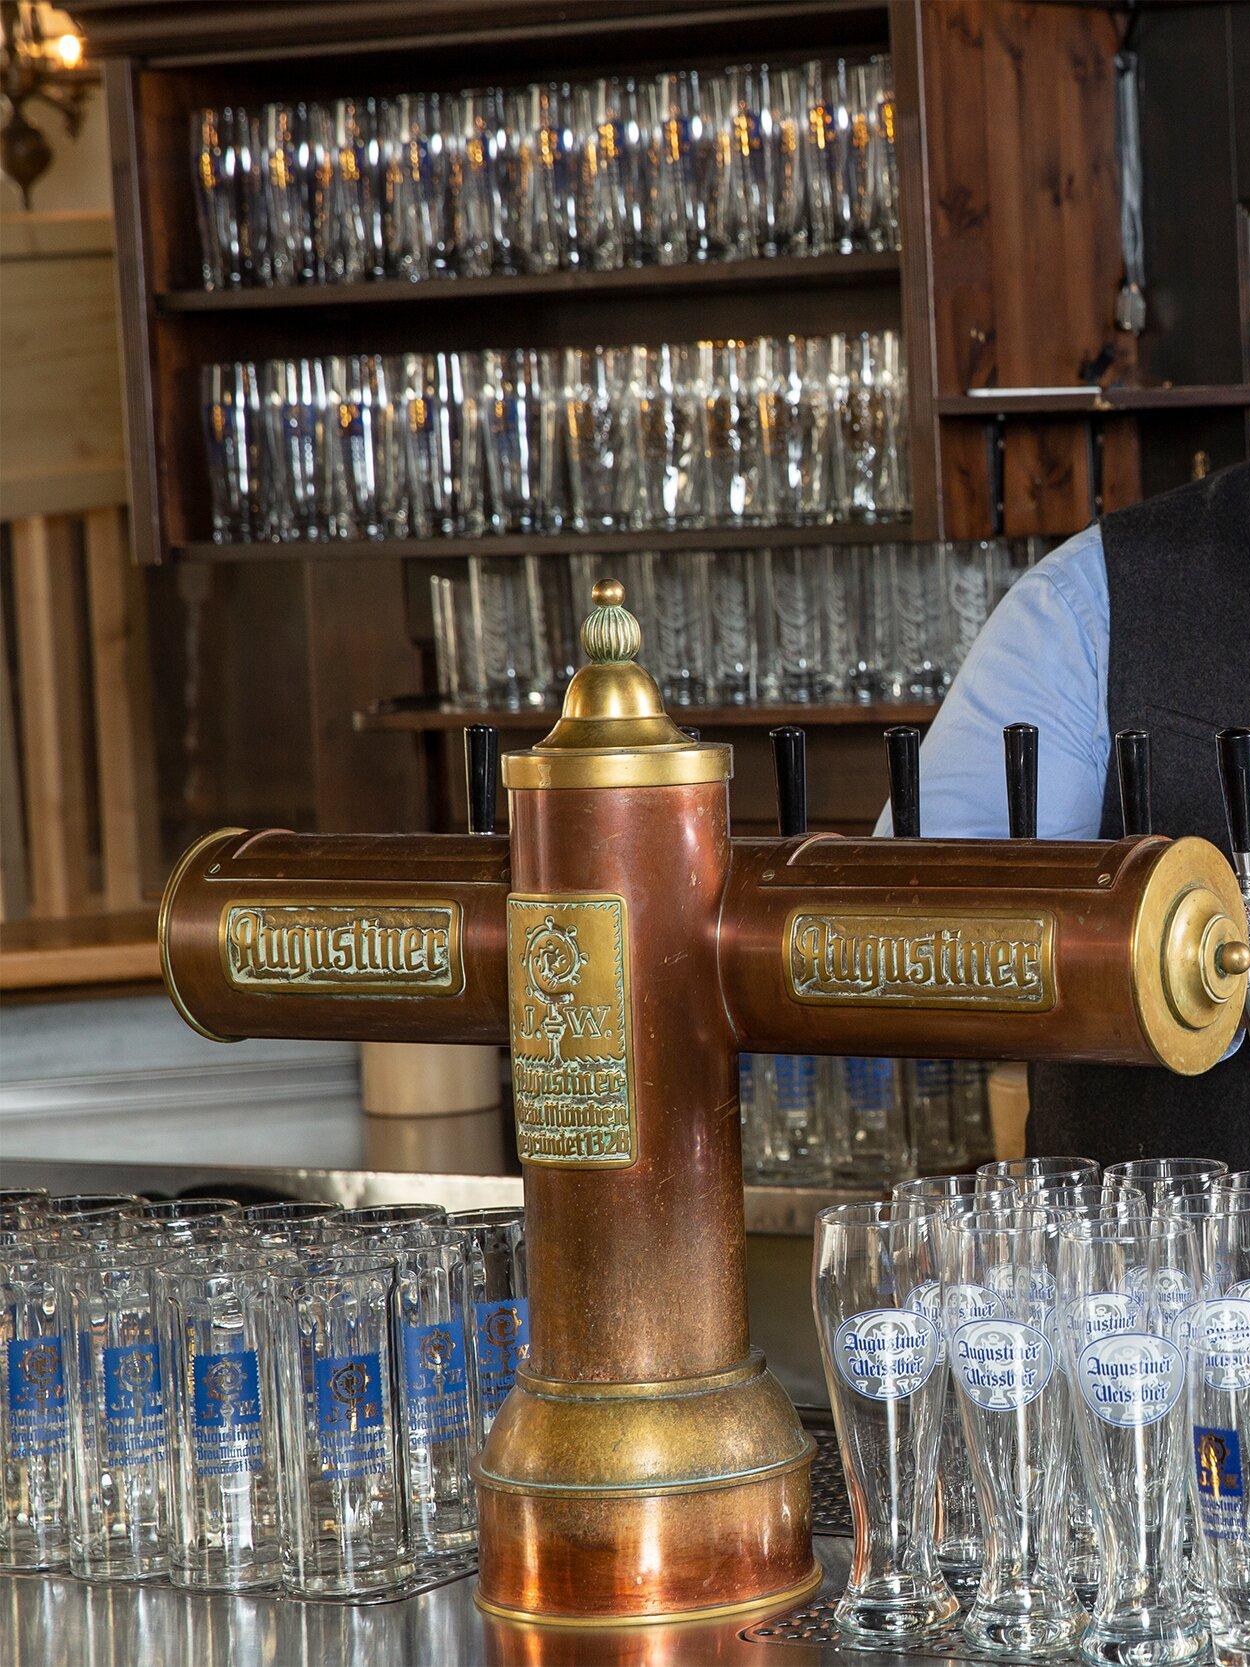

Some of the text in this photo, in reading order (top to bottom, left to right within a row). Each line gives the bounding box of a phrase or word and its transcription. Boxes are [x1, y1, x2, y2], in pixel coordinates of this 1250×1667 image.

[230, 911, 448, 977] Augustiner
[795, 917, 1038, 992] Augustiner
[562, 1004, 613, 1040] W.
[958, 1340, 1041, 1364] Augustier
[963, 1365, 1037, 1387] Weissber
[1092, 1381, 1168, 1403] Weisbier
